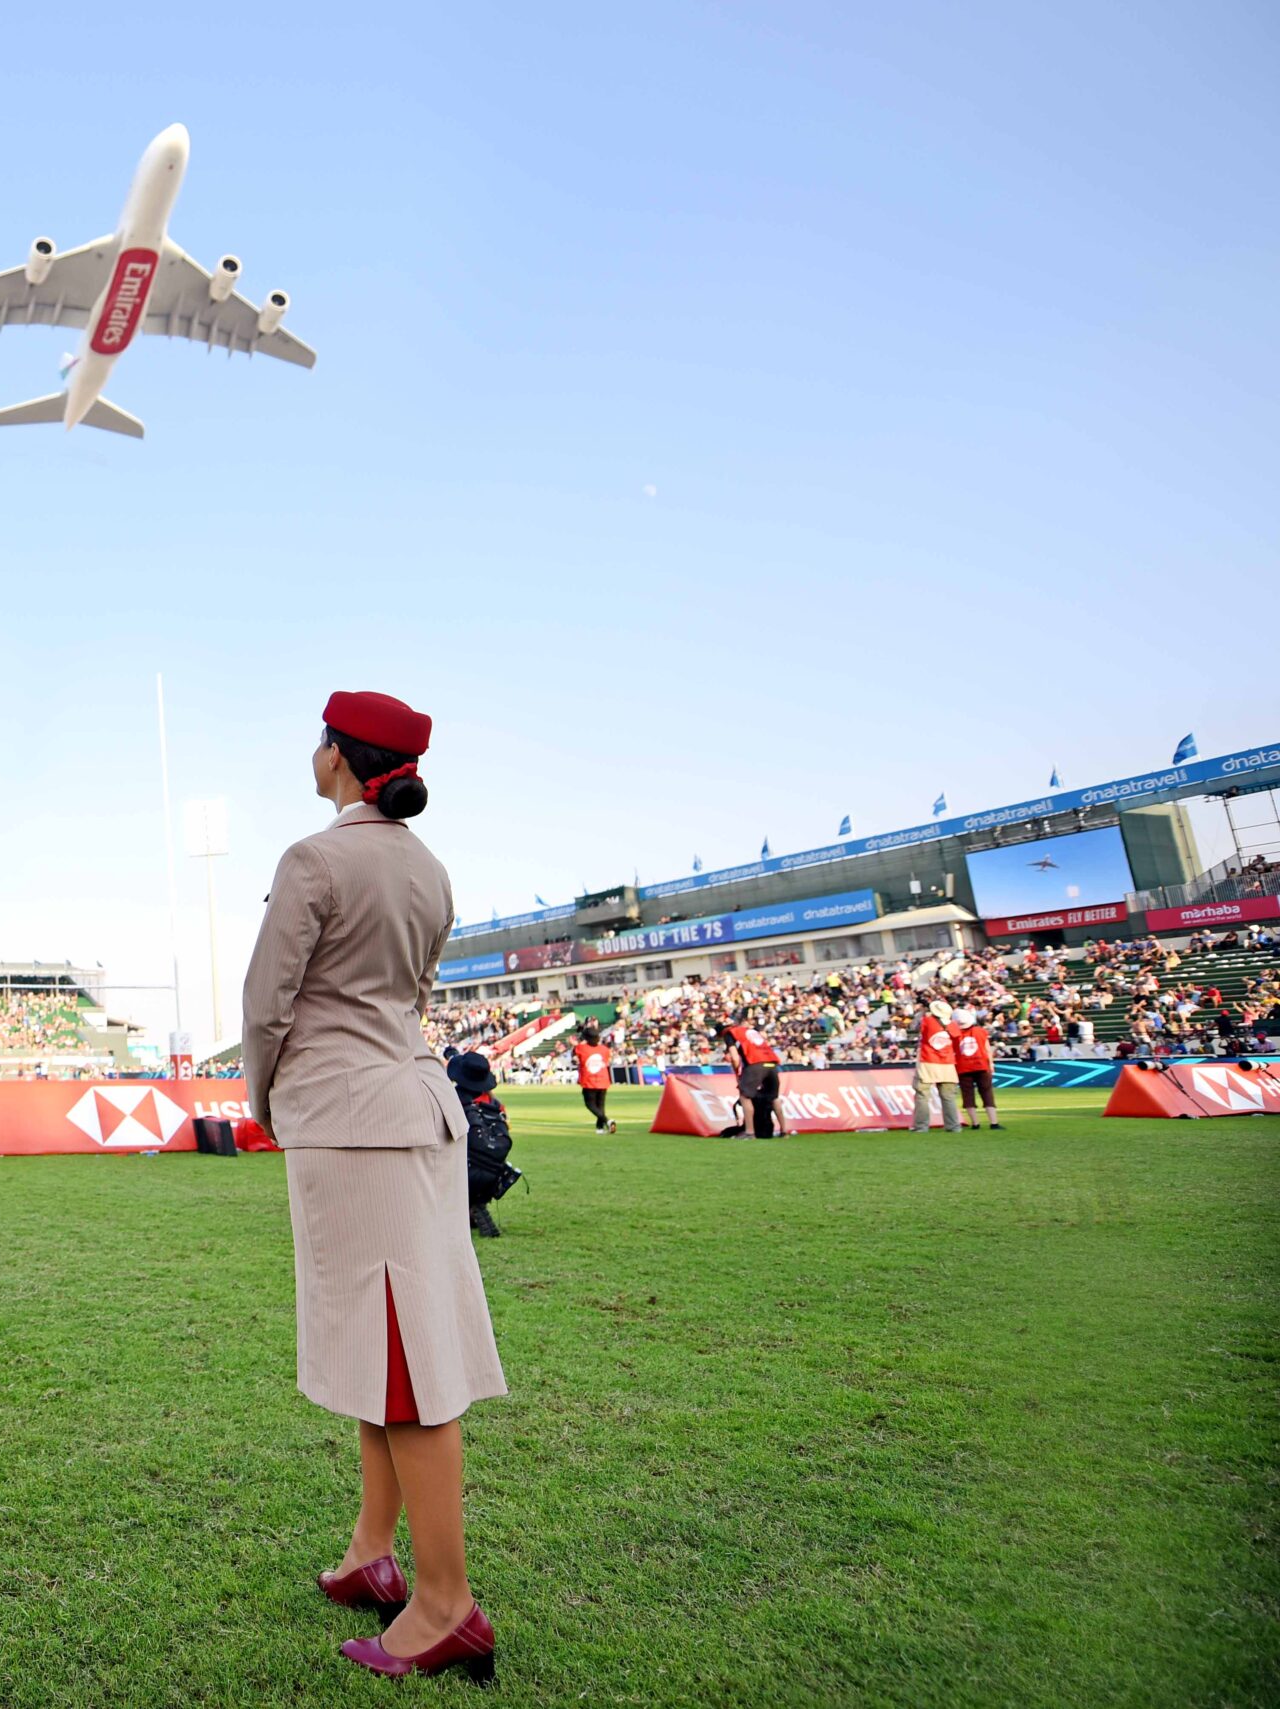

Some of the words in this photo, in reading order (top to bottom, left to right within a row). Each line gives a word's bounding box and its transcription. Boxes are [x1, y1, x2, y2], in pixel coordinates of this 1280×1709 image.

[101, 262, 152, 345] Emirates
[1006, 915, 1064, 932] Emirates
[1067, 911, 1083, 924] FLY
[1084, 906, 1117, 921] BETTER
[596, 934, 646, 955] SOUNDS
[649, 930, 667, 948] OF
[670, 924, 700, 945] THE
[703, 920, 723, 939] 7S
[838, 1086, 882, 1118] FLY
